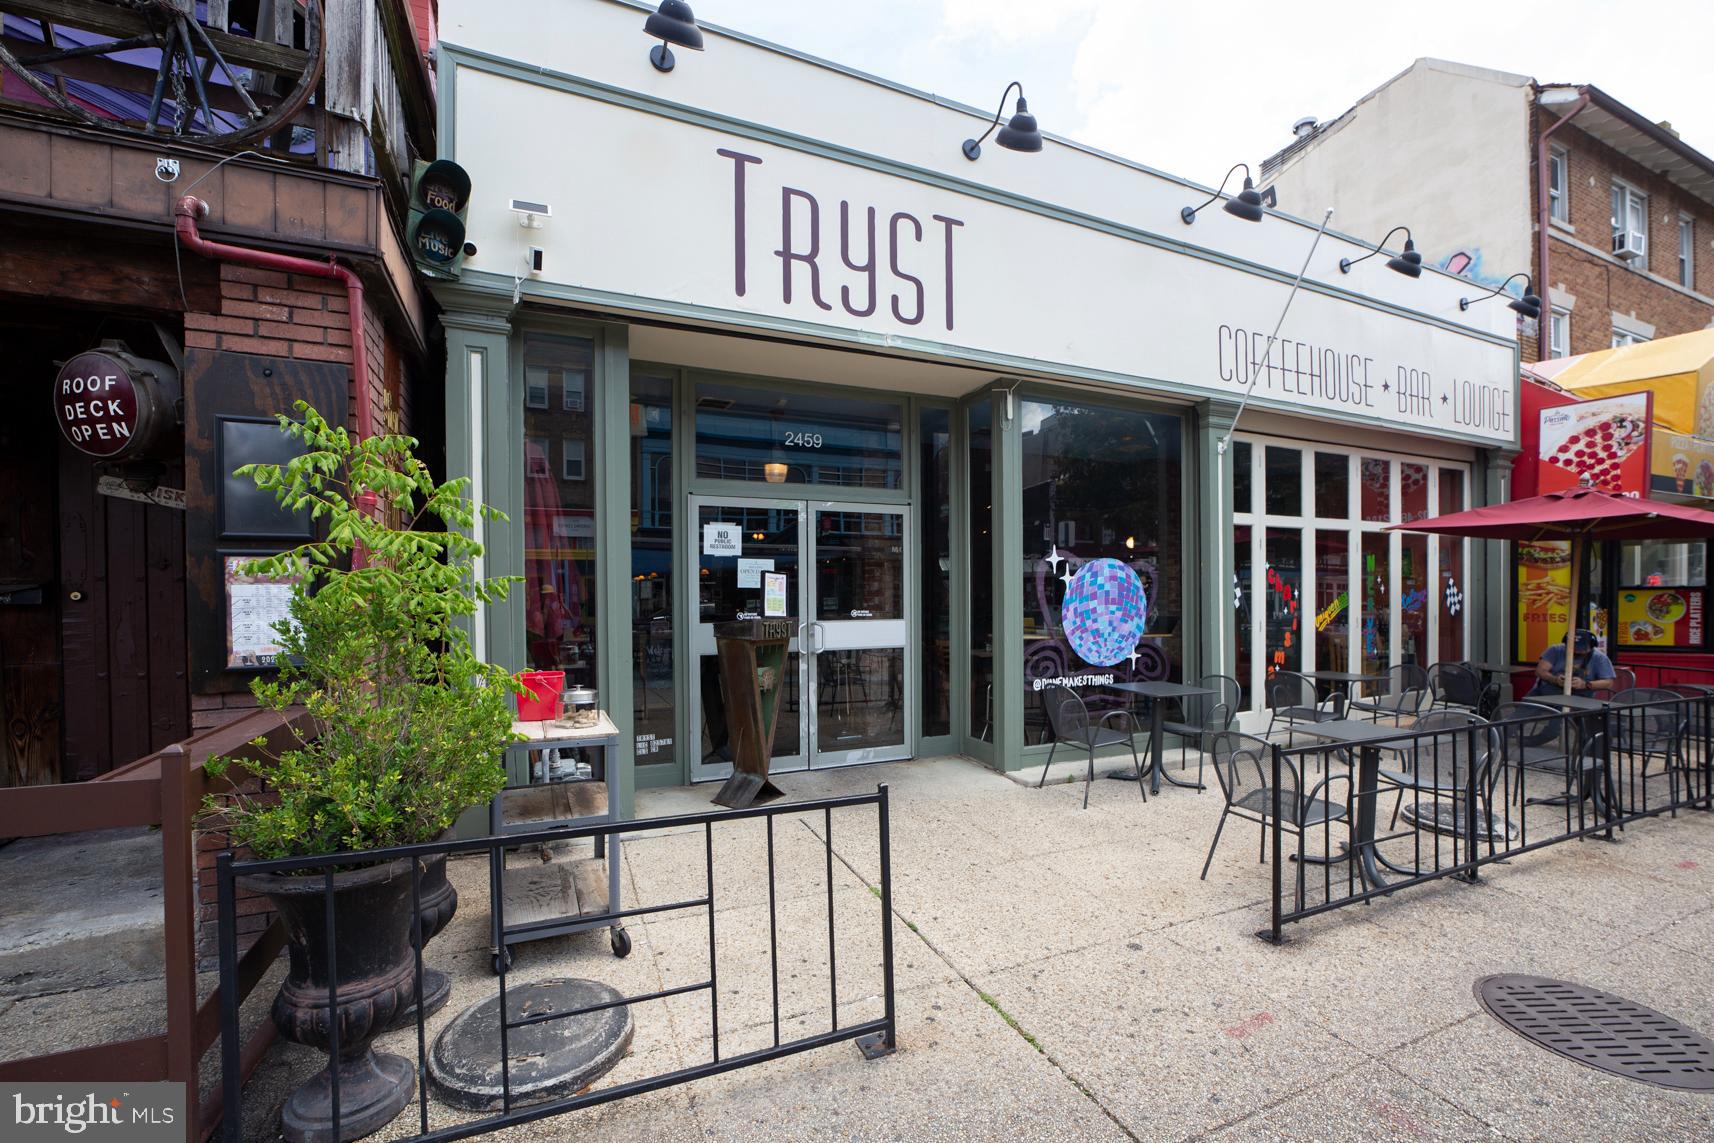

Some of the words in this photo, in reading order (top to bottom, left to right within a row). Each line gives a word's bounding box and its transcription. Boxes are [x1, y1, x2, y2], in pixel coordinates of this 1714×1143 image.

[427, 190, 456, 212] Food
[418, 237, 455, 258] Music
[716, 148, 964, 332] TRYST
[62, 375, 117, 395] ROOF
[1218, 325, 1375, 408] COFFEEHOUSE
[1396, 365, 1433, 418] BAR
[1453, 378, 1510, 433] LOUNGE
[65, 399, 125, 421] DECK
[71, 421, 131, 442] OPEN
[785, 431, 823, 448] 2459
[717, 530, 729, 539] NO
[1522, 612, 1568, 623] FRIES
[1689, 591, 1702, 625] PLATTERS
